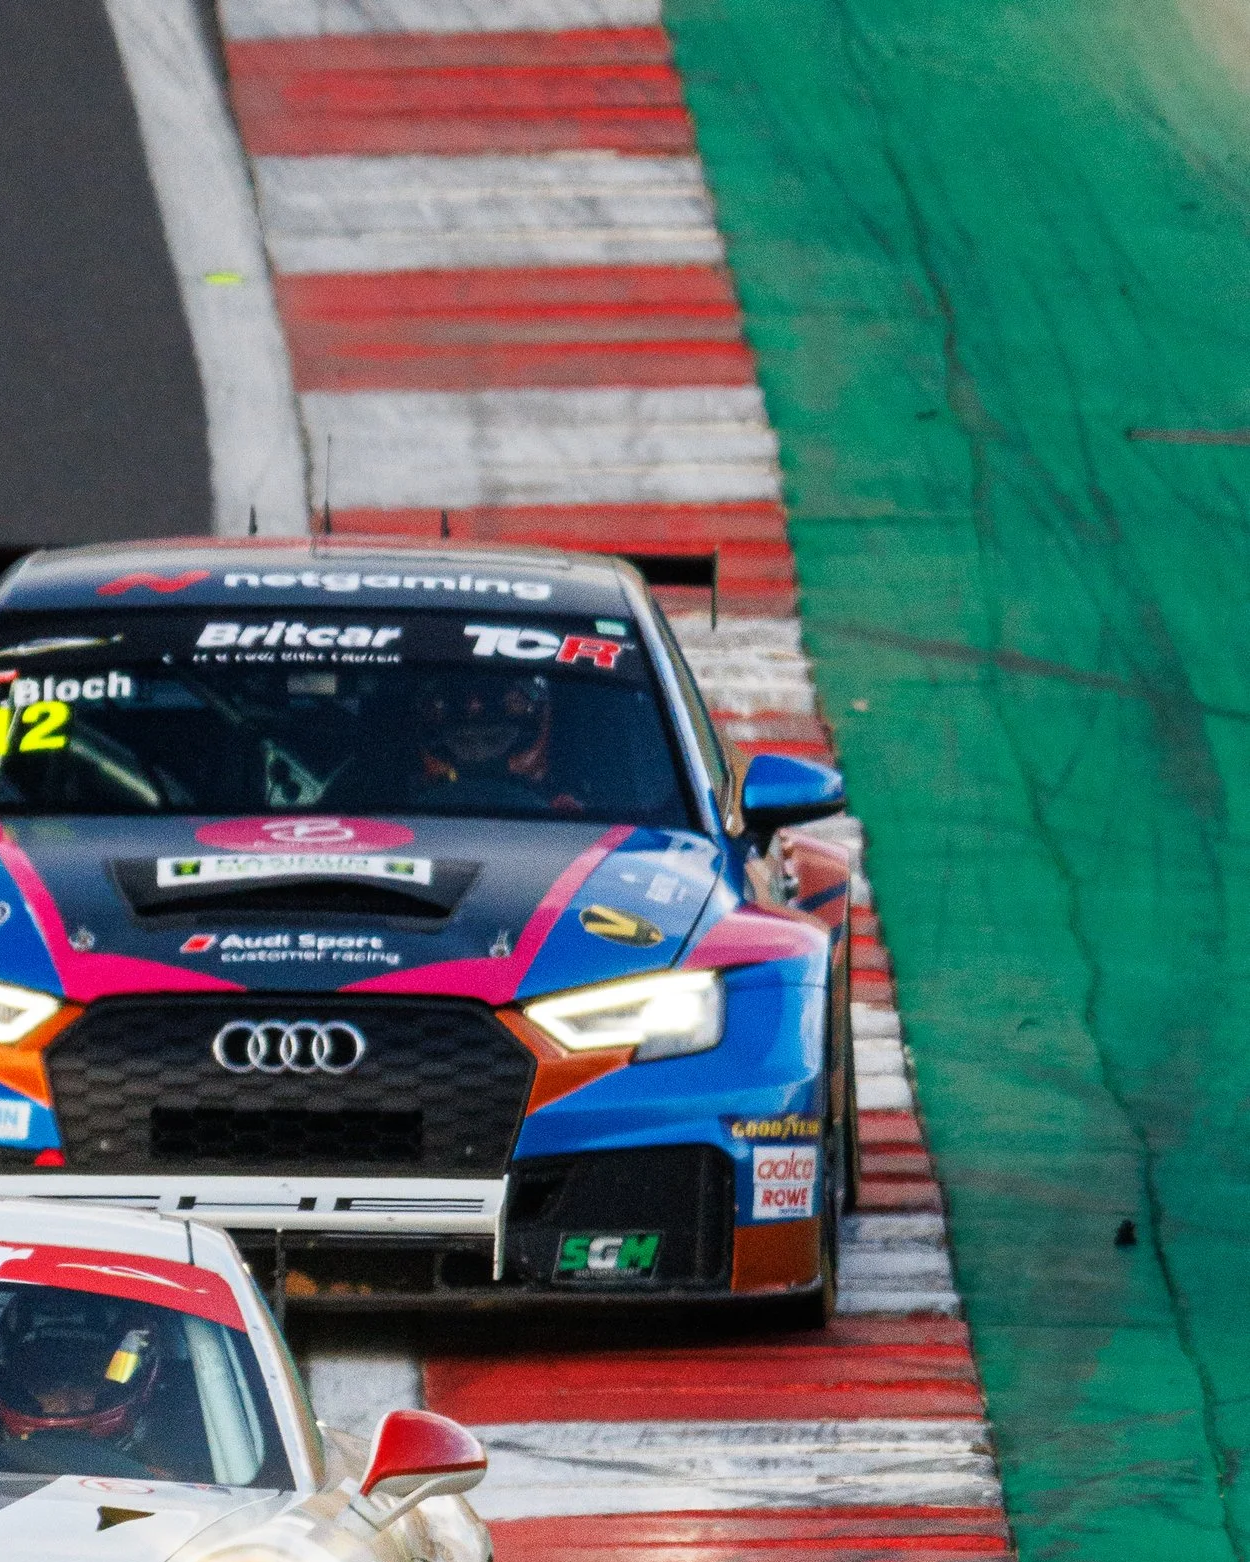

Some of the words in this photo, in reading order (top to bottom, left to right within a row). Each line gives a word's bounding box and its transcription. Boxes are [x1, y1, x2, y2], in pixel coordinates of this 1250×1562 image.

[223, 572, 551, 601] netgaming
[196, 620, 402, 648] Britcar
[463, 624, 621, 669] TCR
[219, 934, 291, 949] Audi
[298, 934, 384, 951] Sport
[221, 950, 323, 963] customer
[333, 950, 402, 966] racing
[761, 1187, 808, 1208] ROWE
[558, 1233, 660, 1271] SGM
